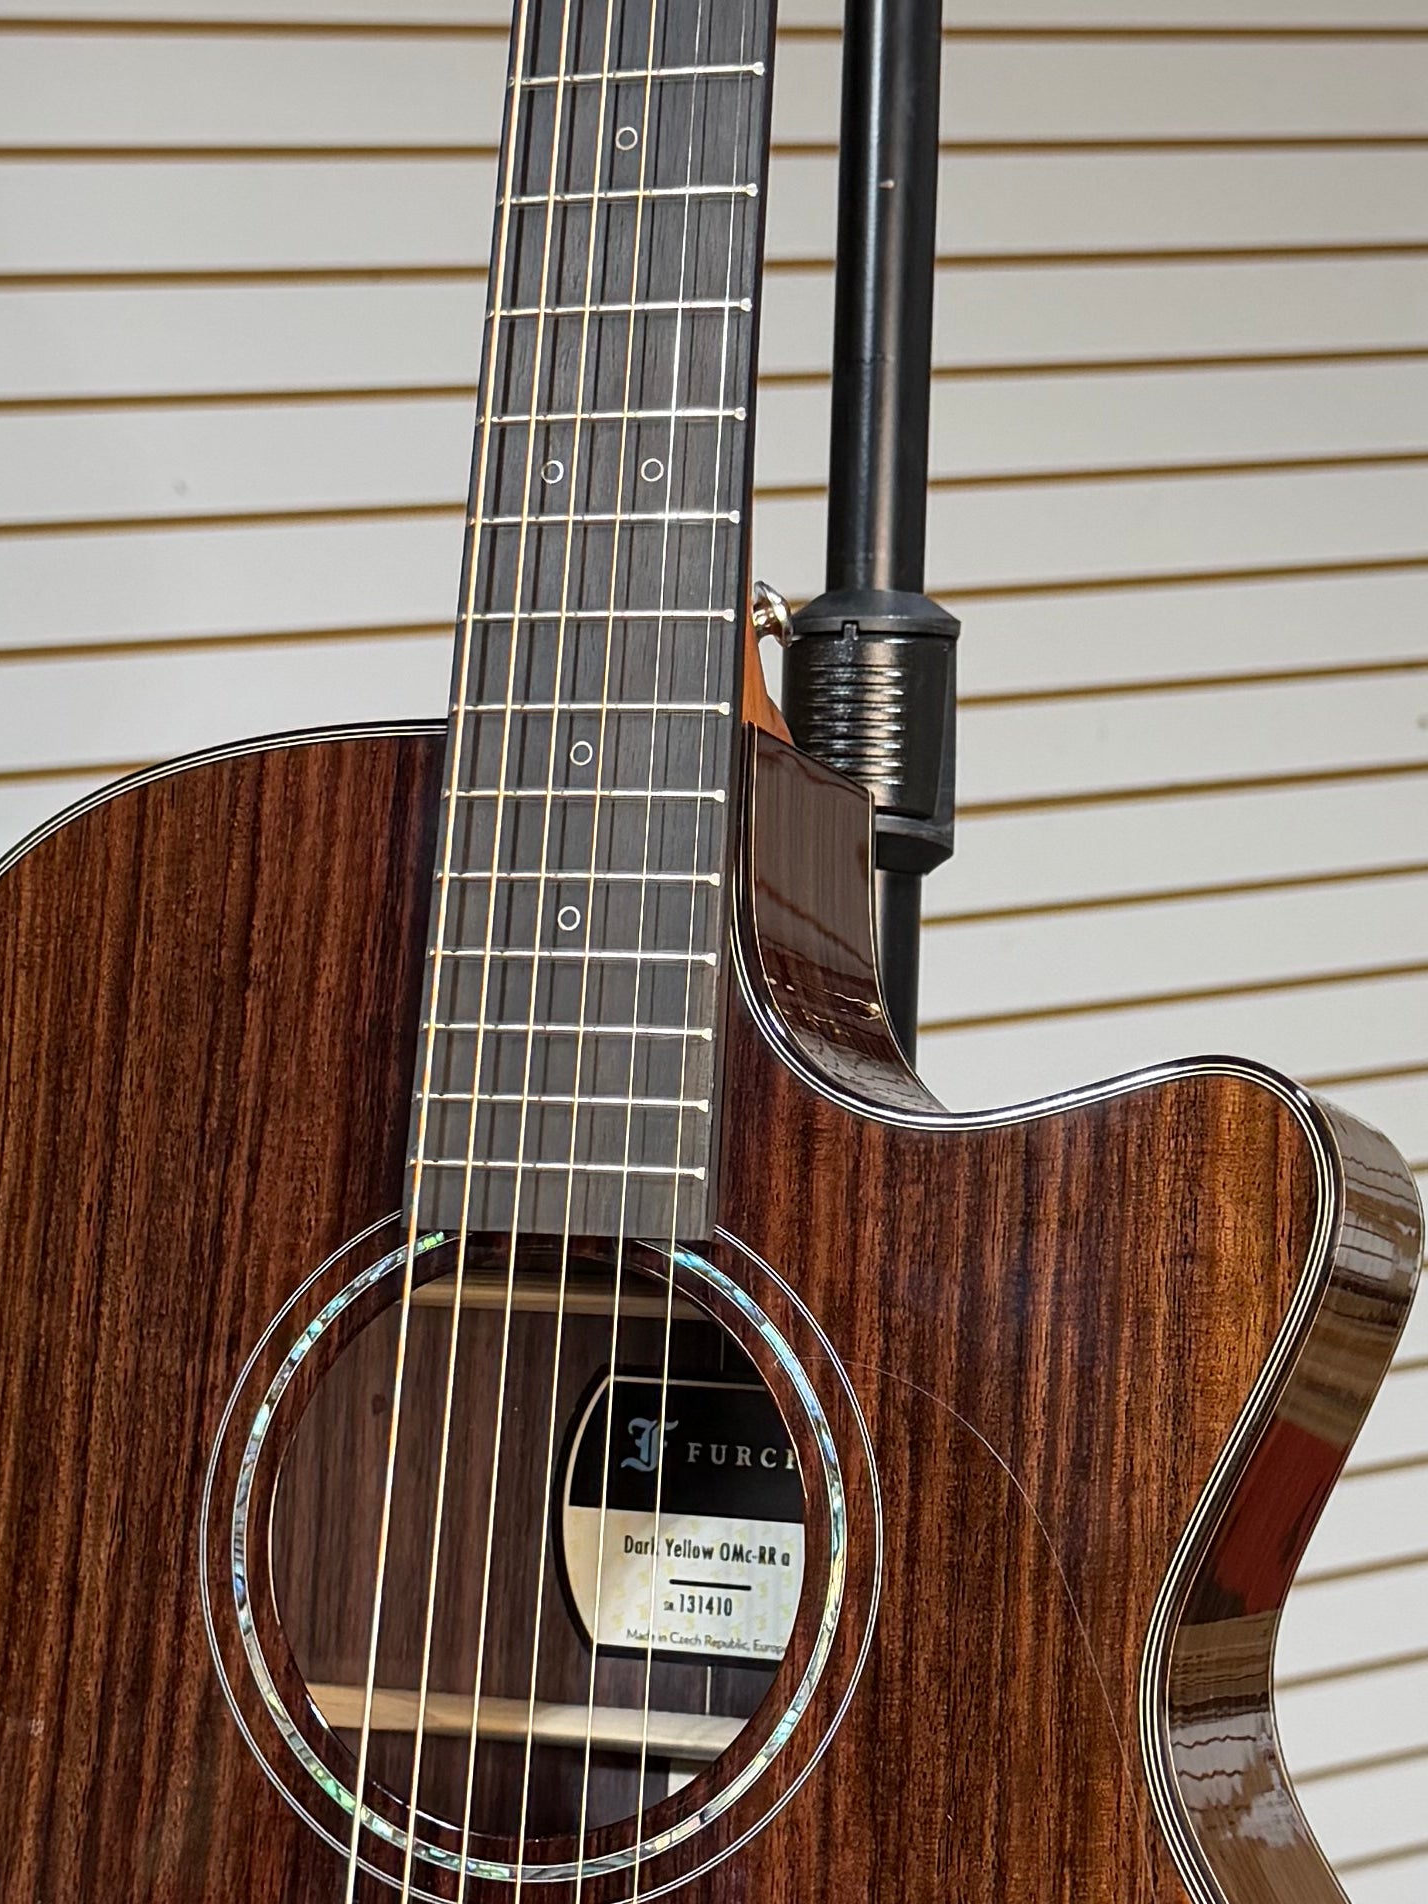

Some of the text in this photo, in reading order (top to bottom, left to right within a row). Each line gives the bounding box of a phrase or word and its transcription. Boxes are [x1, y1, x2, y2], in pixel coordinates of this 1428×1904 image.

[665, 1538, 715, 1561] Yellow
[719, 1542, 777, 1566] OMc-RR
[679, 1593, 733, 1617] 131410
[669, 1631, 702, 1646] Czech
[752, 1640, 786, 1655] Europ
